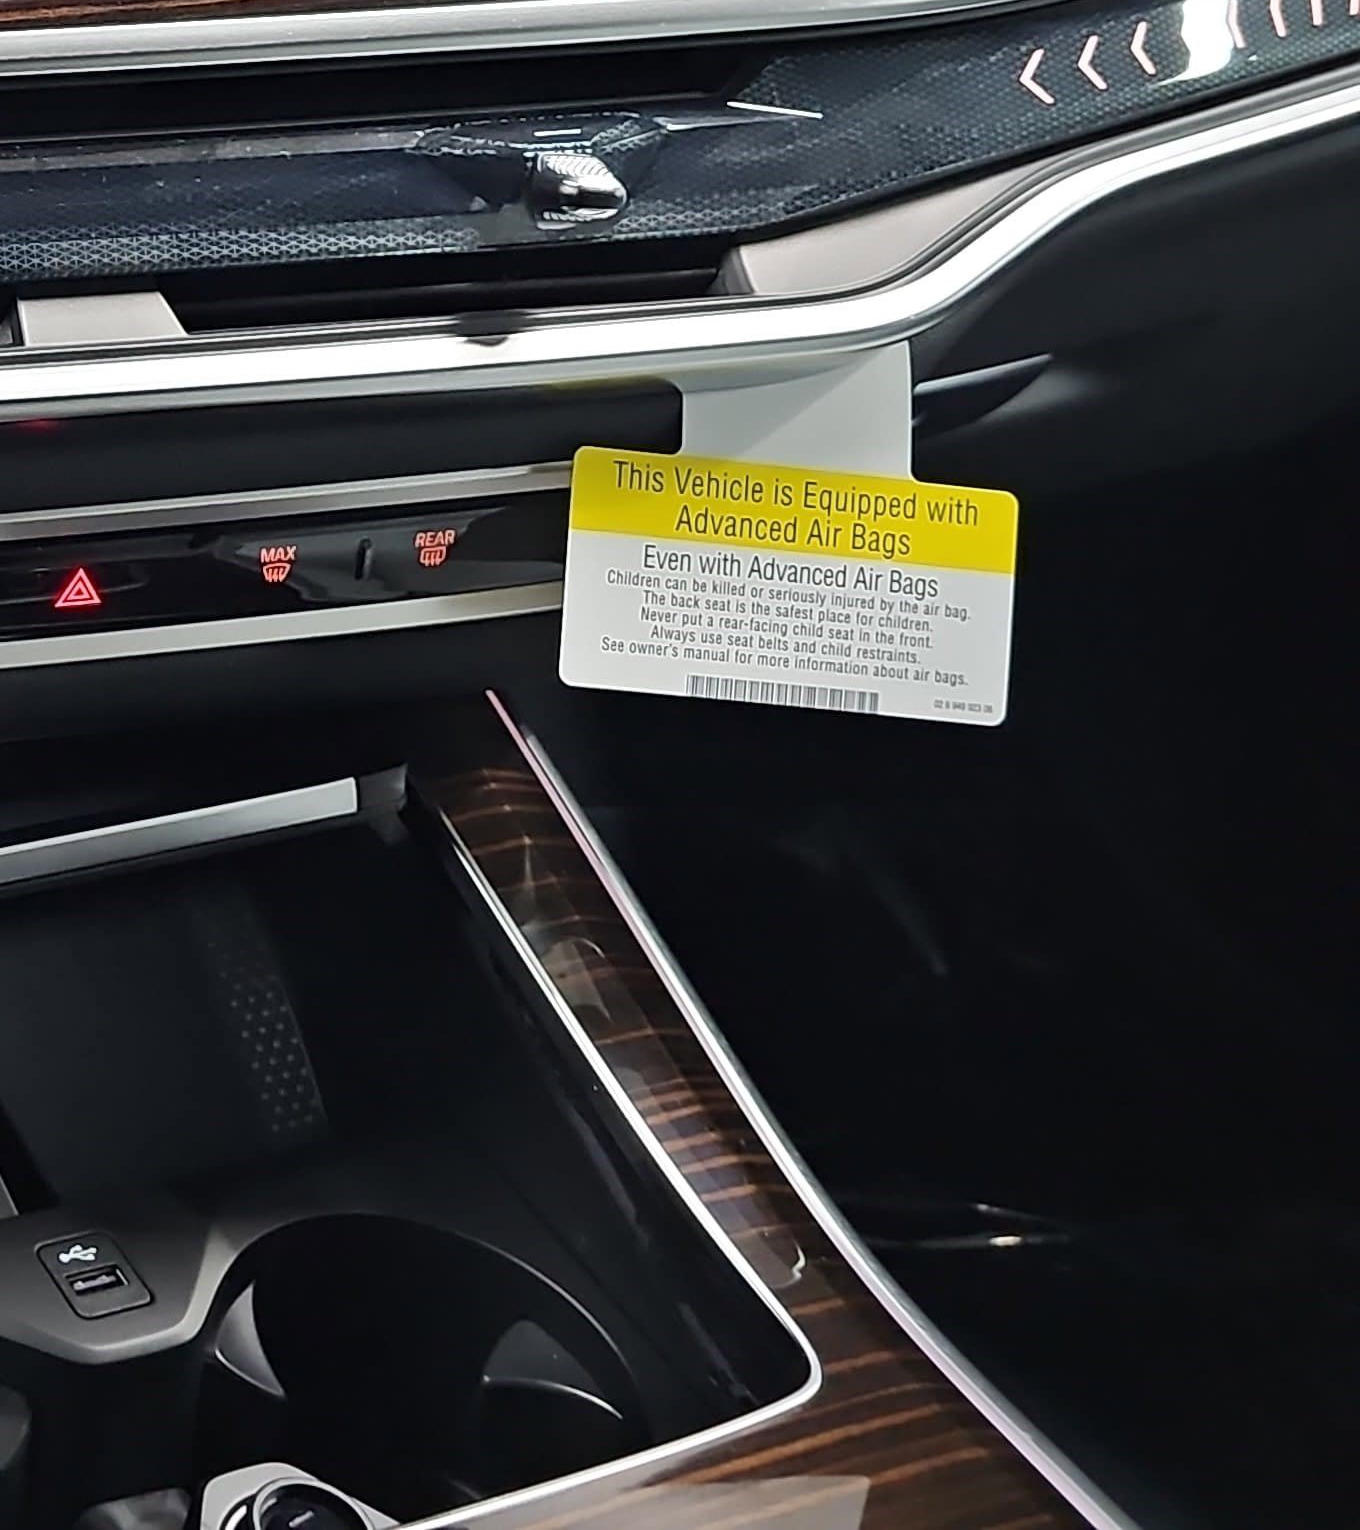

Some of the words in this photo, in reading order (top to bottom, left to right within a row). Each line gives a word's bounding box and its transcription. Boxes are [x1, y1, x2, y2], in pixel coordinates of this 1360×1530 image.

[613, 460, 664, 492] This
[675, 467, 763, 503] Vehicle
[774, 478, 792, 506] is
[804, 481, 916, 522] Equipped
[927, 497, 977, 526] with
[260, 545, 296, 562] MAX
[414, 529, 455, 547] REAR
[675, 505, 797, 543] Advanced
[807, 519, 842, 548] Air
[852, 523, 910, 560] Bags
[644, 544, 691, 572] Even
[699, 552, 741, 577] with
[748, 556, 847, 588] Advanced
[853, 566, 884, 591] Air
[889, 570, 938, 601] Bags
[608, 570, 659, 587] Children
[665, 579, 687, 590] can
[693, 579, 706, 592] be
[712, 581, 745, 596] killed
[751, 587, 764, 598] or
[769, 589, 826, 607] seriously
[831, 594, 874, 609] injured
[880, 599, 894, 614] by
[900, 601, 917, 614] the
[923, 605, 939, 615] air
[945, 606, 971, 622] bag.
[644, 591, 665, 605] The
[671, 594, 700, 608] back
[705, 600, 730, 611] seat
[736, 600, 745, 613] is
[752, 602, 770, 615] the
[776, 606, 812, 620] safest
[819, 609, 850, 623] place
[857, 612, 874, 625] for
[878, 615, 933, 632] children.
[641, 607, 677, 623] Never
[682, 613, 702, 627] put
[707, 616, 713, 627] a
[719, 618, 788, 637] rear-facing
[793, 623, 823, 638] child
[828, 628, 854, 641] seat
[859, 629, 870, 642] in
[876, 631, 894, 645] the
[900, 633, 933, 648] front.
[651, 625, 696, 644] Always
[701, 632, 722, 644] use
[727, 635, 753, 647] seat
[759, 636, 788, 651] belts
[793, 641, 815, 653] and
[821, 643, 851, 657] child
[857, 648, 920, 664] restraints.
[602, 637, 624, 652] See
[629, 642, 678, 657] owner's
[684, 648, 729, 662] manual
[735, 650, 751, 664] for
[757, 655, 789, 668] more
[795, 657, 868, 675] information
[873, 665, 908, 679] about
[914, 669, 930, 681] air
[935, 671, 968, 686] bags.
